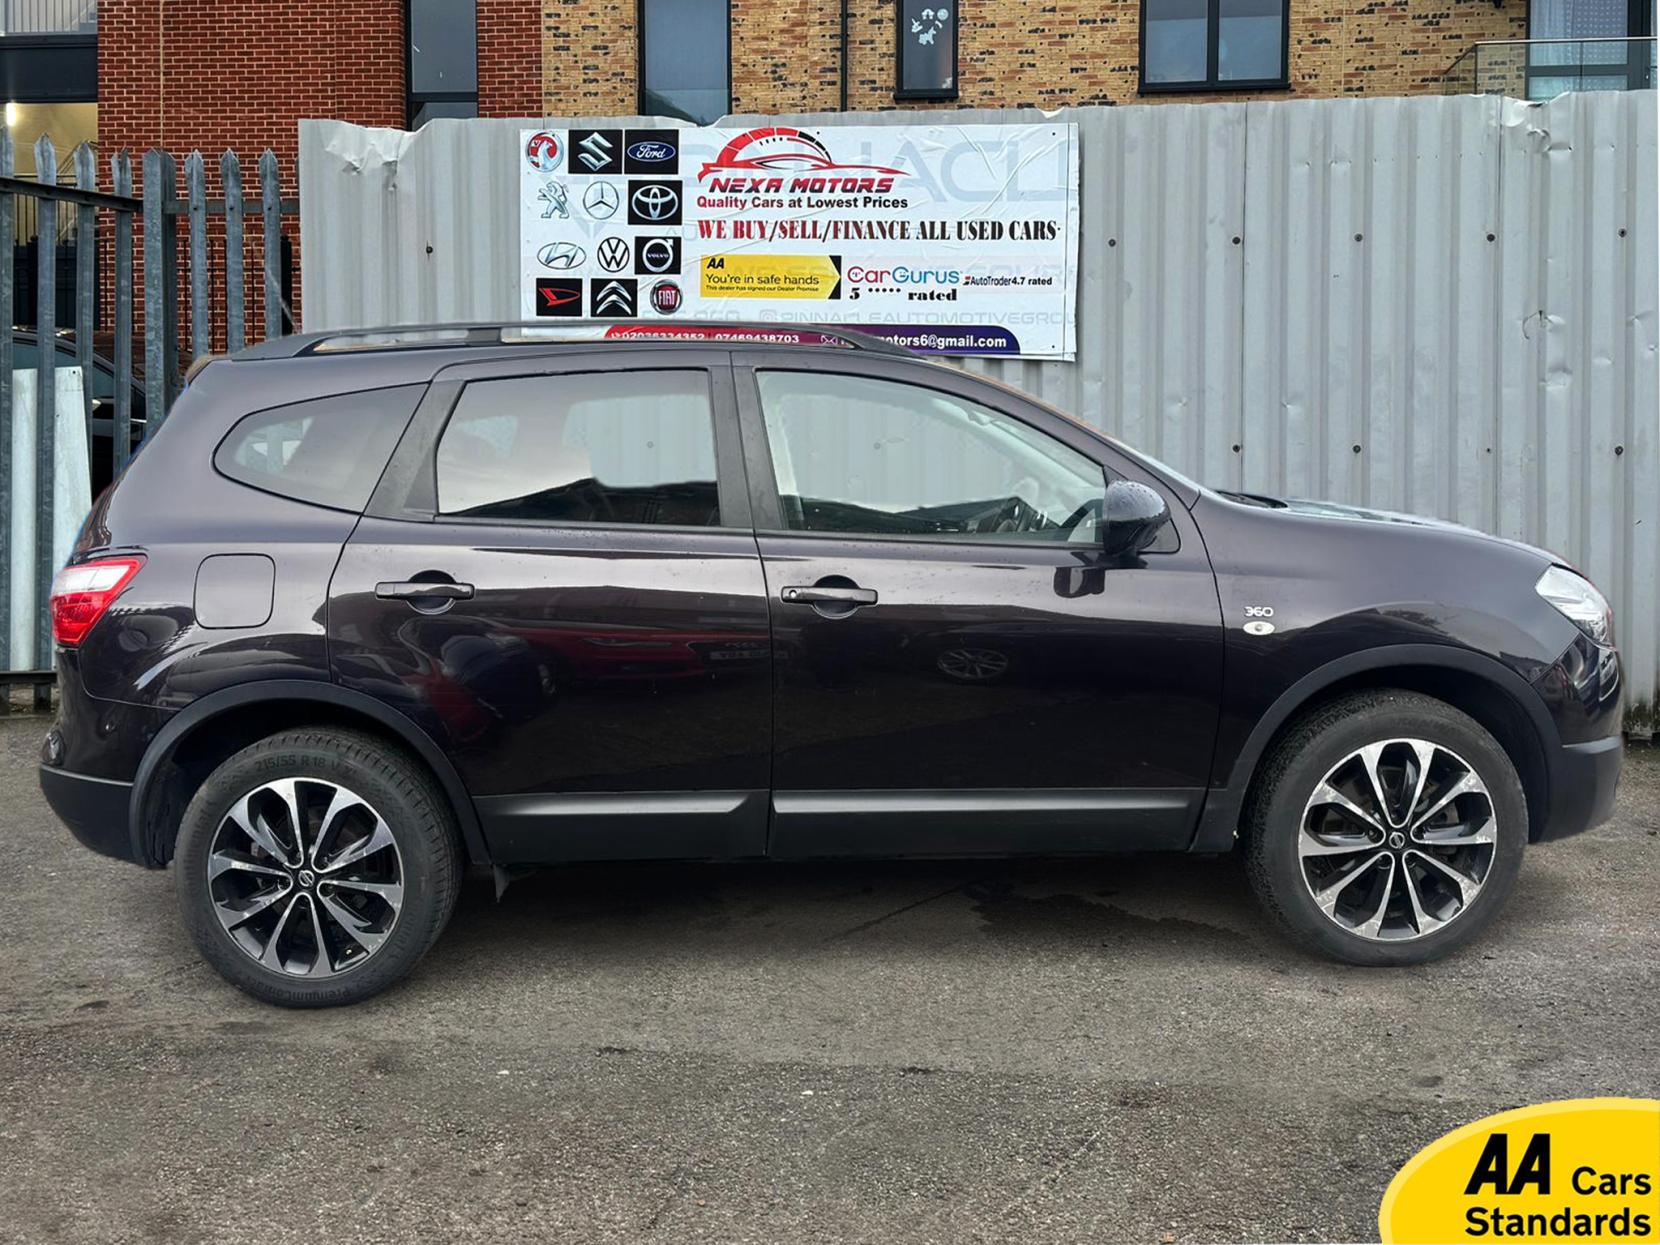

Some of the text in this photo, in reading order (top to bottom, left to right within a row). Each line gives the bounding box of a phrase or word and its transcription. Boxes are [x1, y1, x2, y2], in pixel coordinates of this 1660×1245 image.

[636, 144, 666, 159] Ford
[709, 178, 894, 193] NEXA MOTORS
[697, 195, 908, 210] Quality Cars at Lowest Prices
[698, 220, 726, 239] WE
[733, 219, 910, 243] BUY/SELL/FINANCE
[916, 221, 950, 240] ALL
[956, 221, 1003, 240] USED
[1009, 221, 1057, 241] CARS
[706, 257, 725, 269] AA
[706, 273, 820, 285] You're in safe hands
[847, 265, 960, 284] CarGurus
[1028, 277, 1053, 285] rated
[658, 290, 677, 306] FIAT
[849, 287, 958, 301] 5 rated
[1243, 606, 1274, 617] 360
